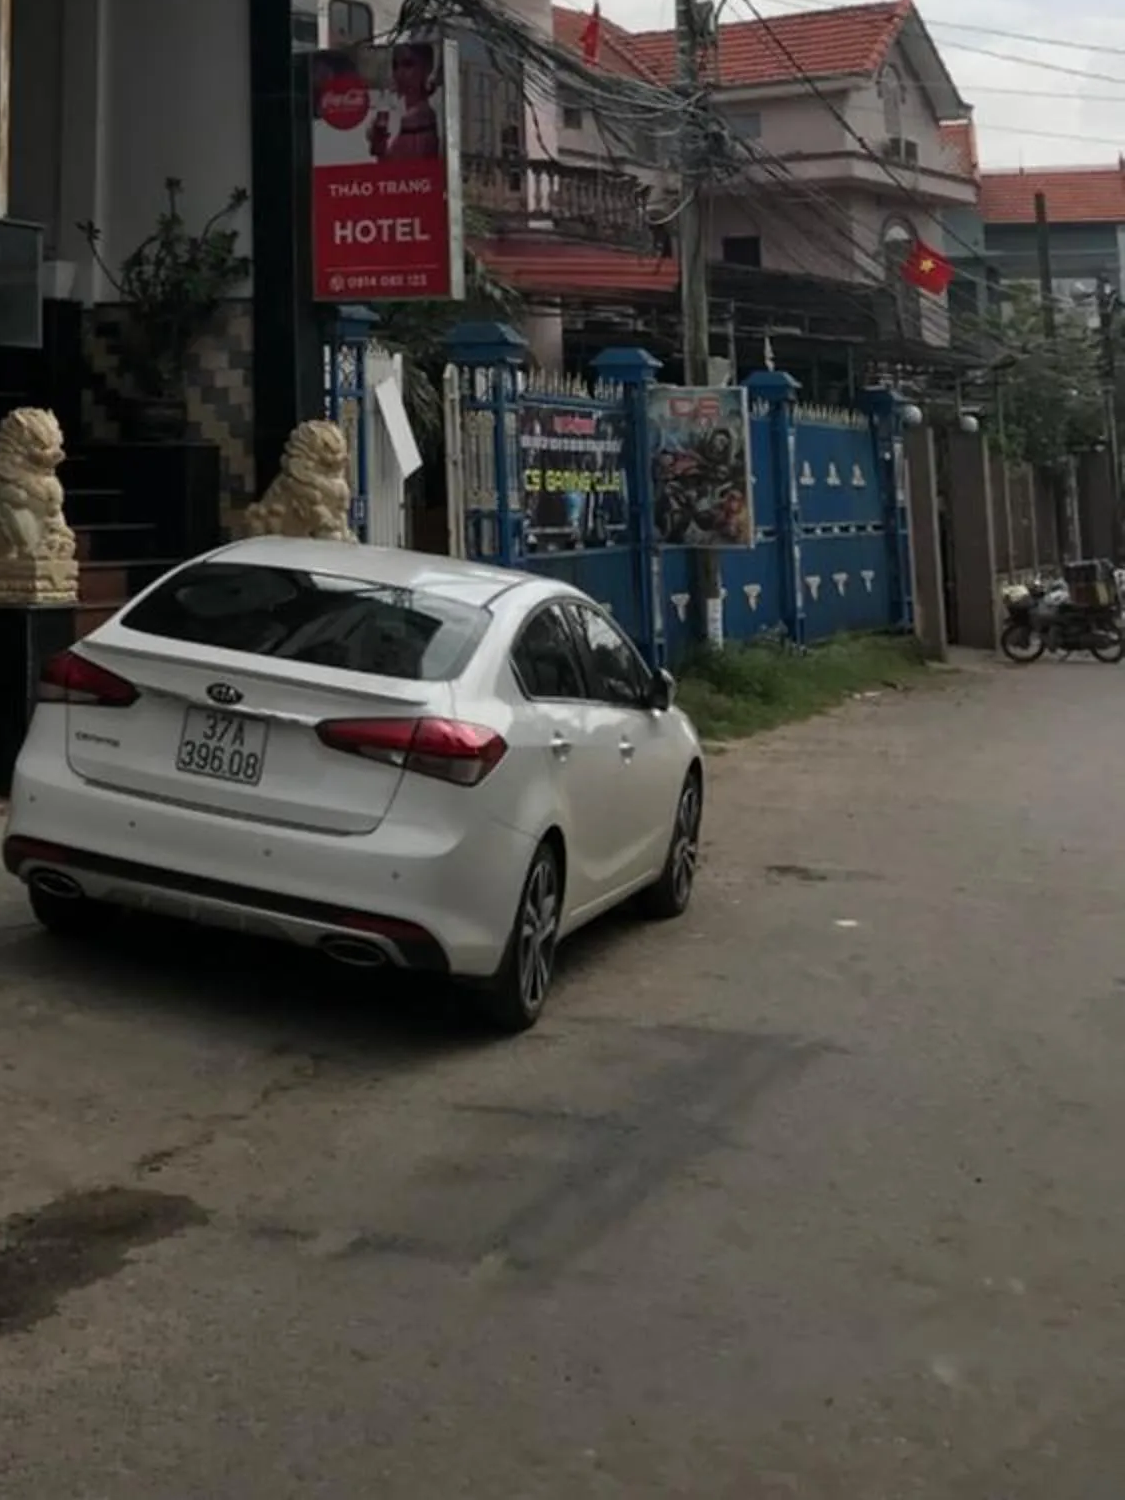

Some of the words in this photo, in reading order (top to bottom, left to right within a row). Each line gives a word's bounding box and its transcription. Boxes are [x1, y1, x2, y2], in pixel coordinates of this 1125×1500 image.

[378, 179, 431, 195] TRANG
[334, 218, 431, 244] HOTEL
[202, 713, 244, 747] 37A
[178, 740, 259, 779] 396.08
